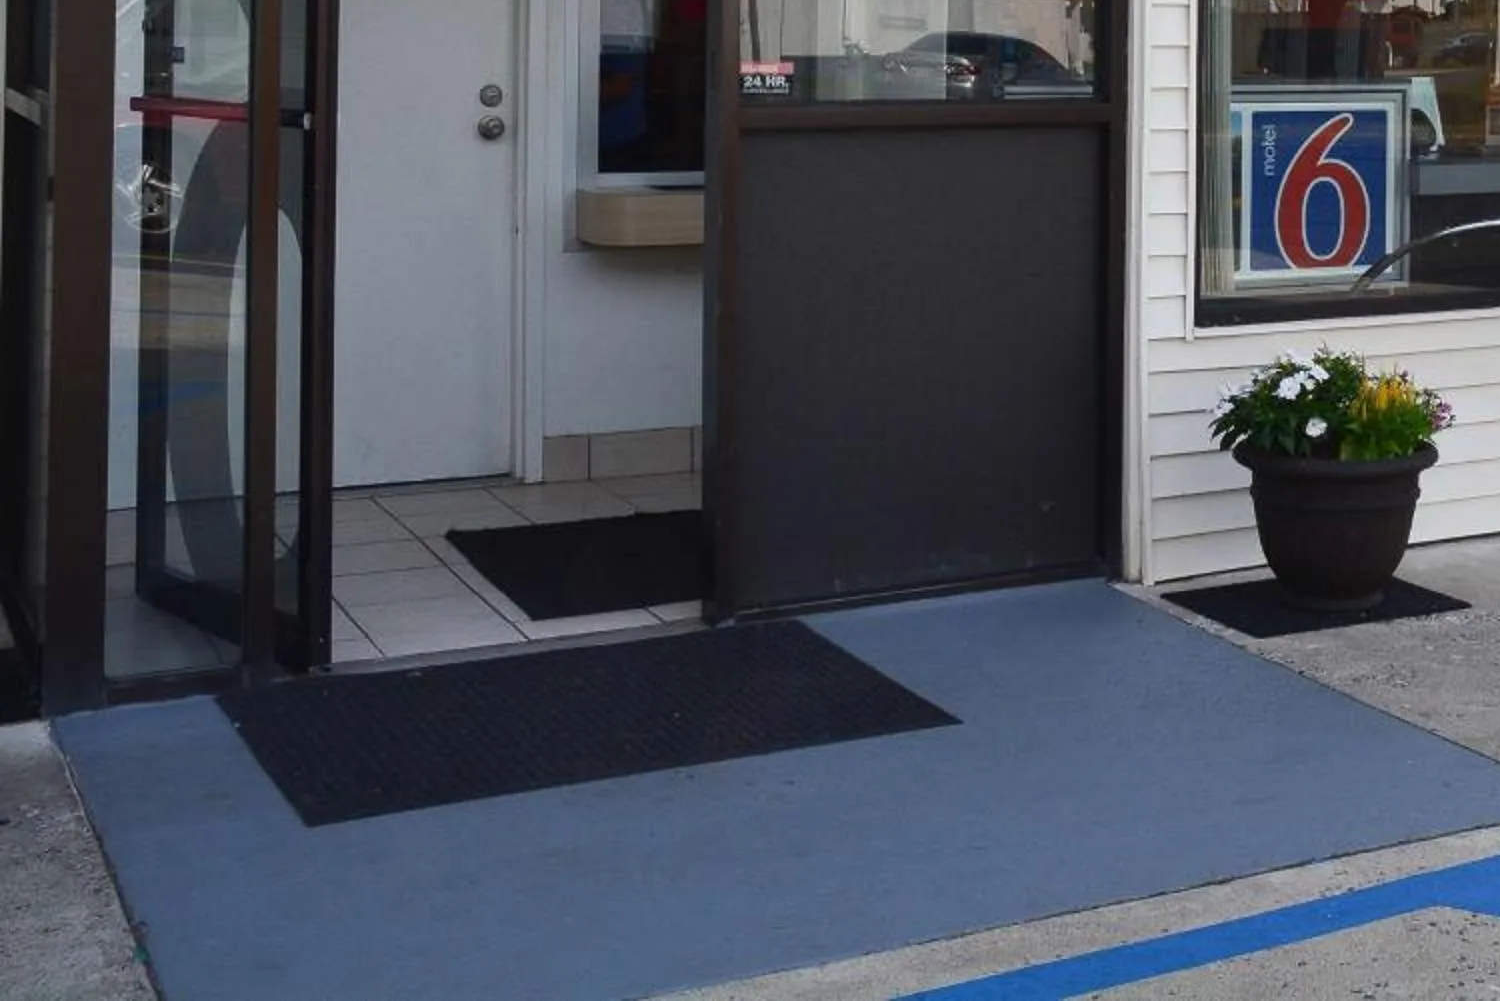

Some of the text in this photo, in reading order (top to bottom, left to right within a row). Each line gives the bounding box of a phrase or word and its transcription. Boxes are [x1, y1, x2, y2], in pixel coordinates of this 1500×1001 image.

[743, 75, 762, 88] 24
[1261, 124, 1278, 176] motel
[1274, 113, 1371, 270] 6
